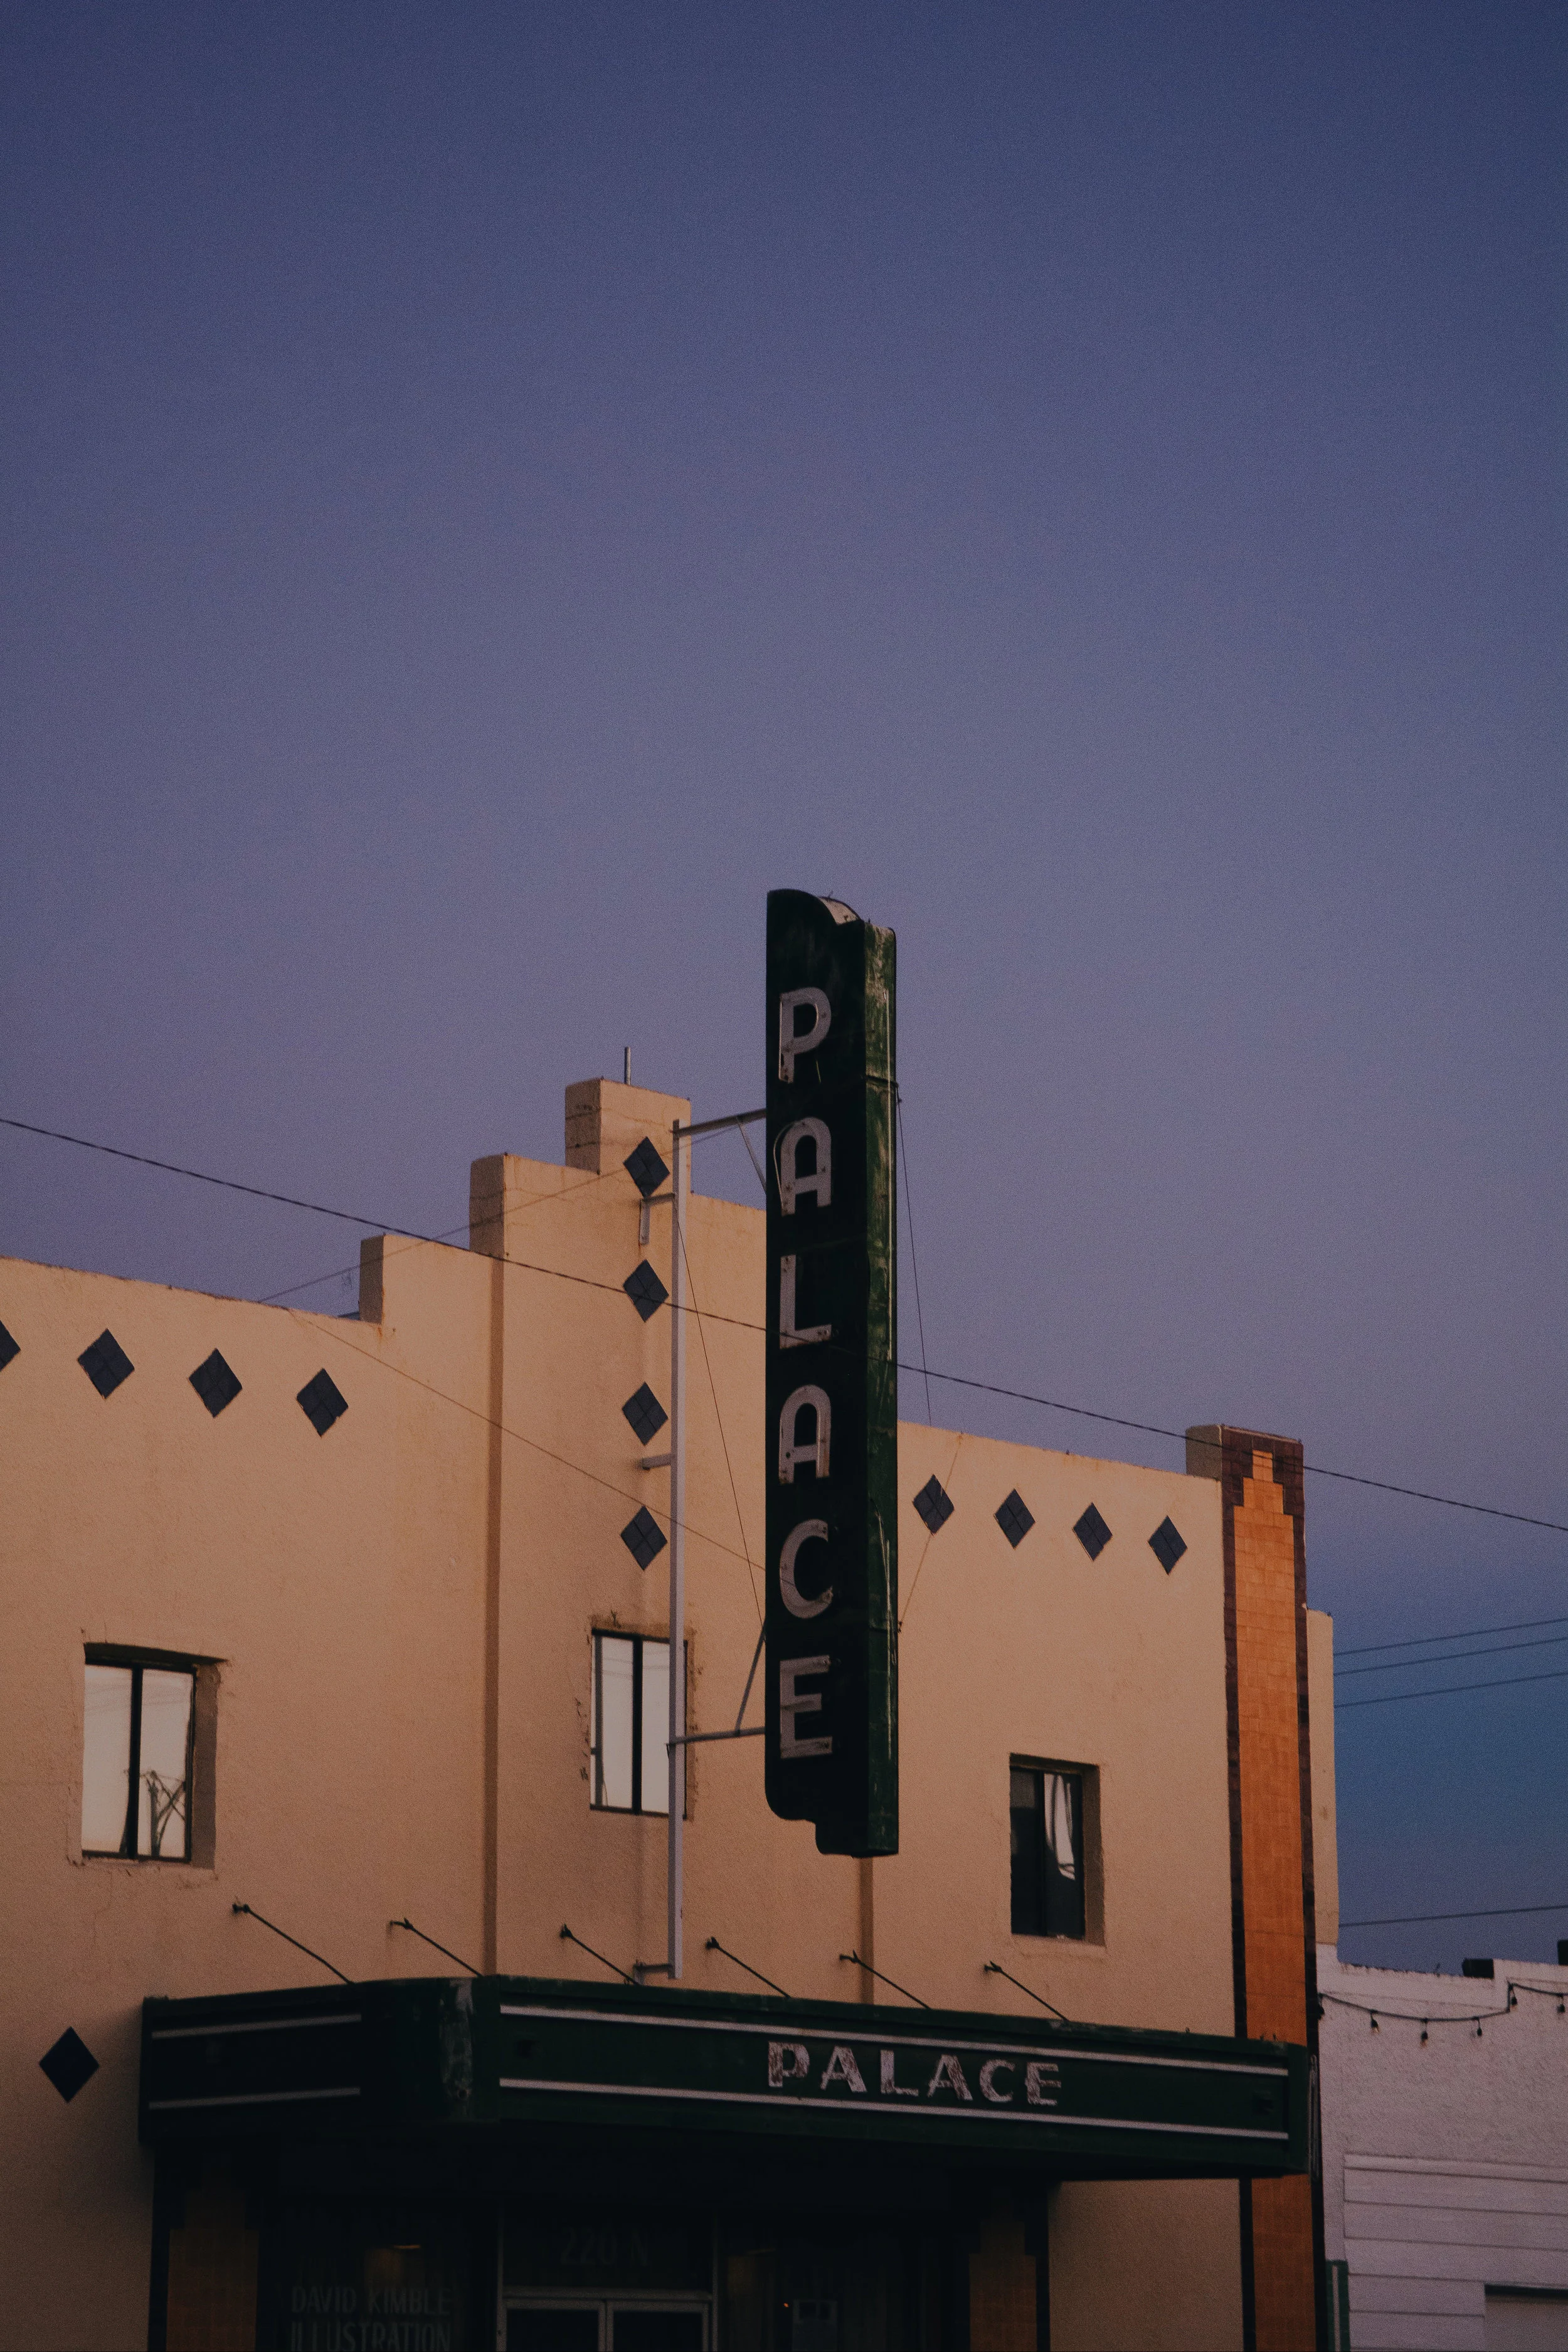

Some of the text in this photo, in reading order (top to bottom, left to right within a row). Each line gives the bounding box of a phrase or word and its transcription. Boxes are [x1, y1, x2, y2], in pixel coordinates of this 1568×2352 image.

[776, 986, 833, 1758] PALACE
[768, 2041, 1062, 2106] PALACE
[560, 2227, 649, 2267] 220 N
[291, 2286, 452, 2316] DAVID KIMBLE
[291, 2321, 452, 2352] ILLUSTRATION
